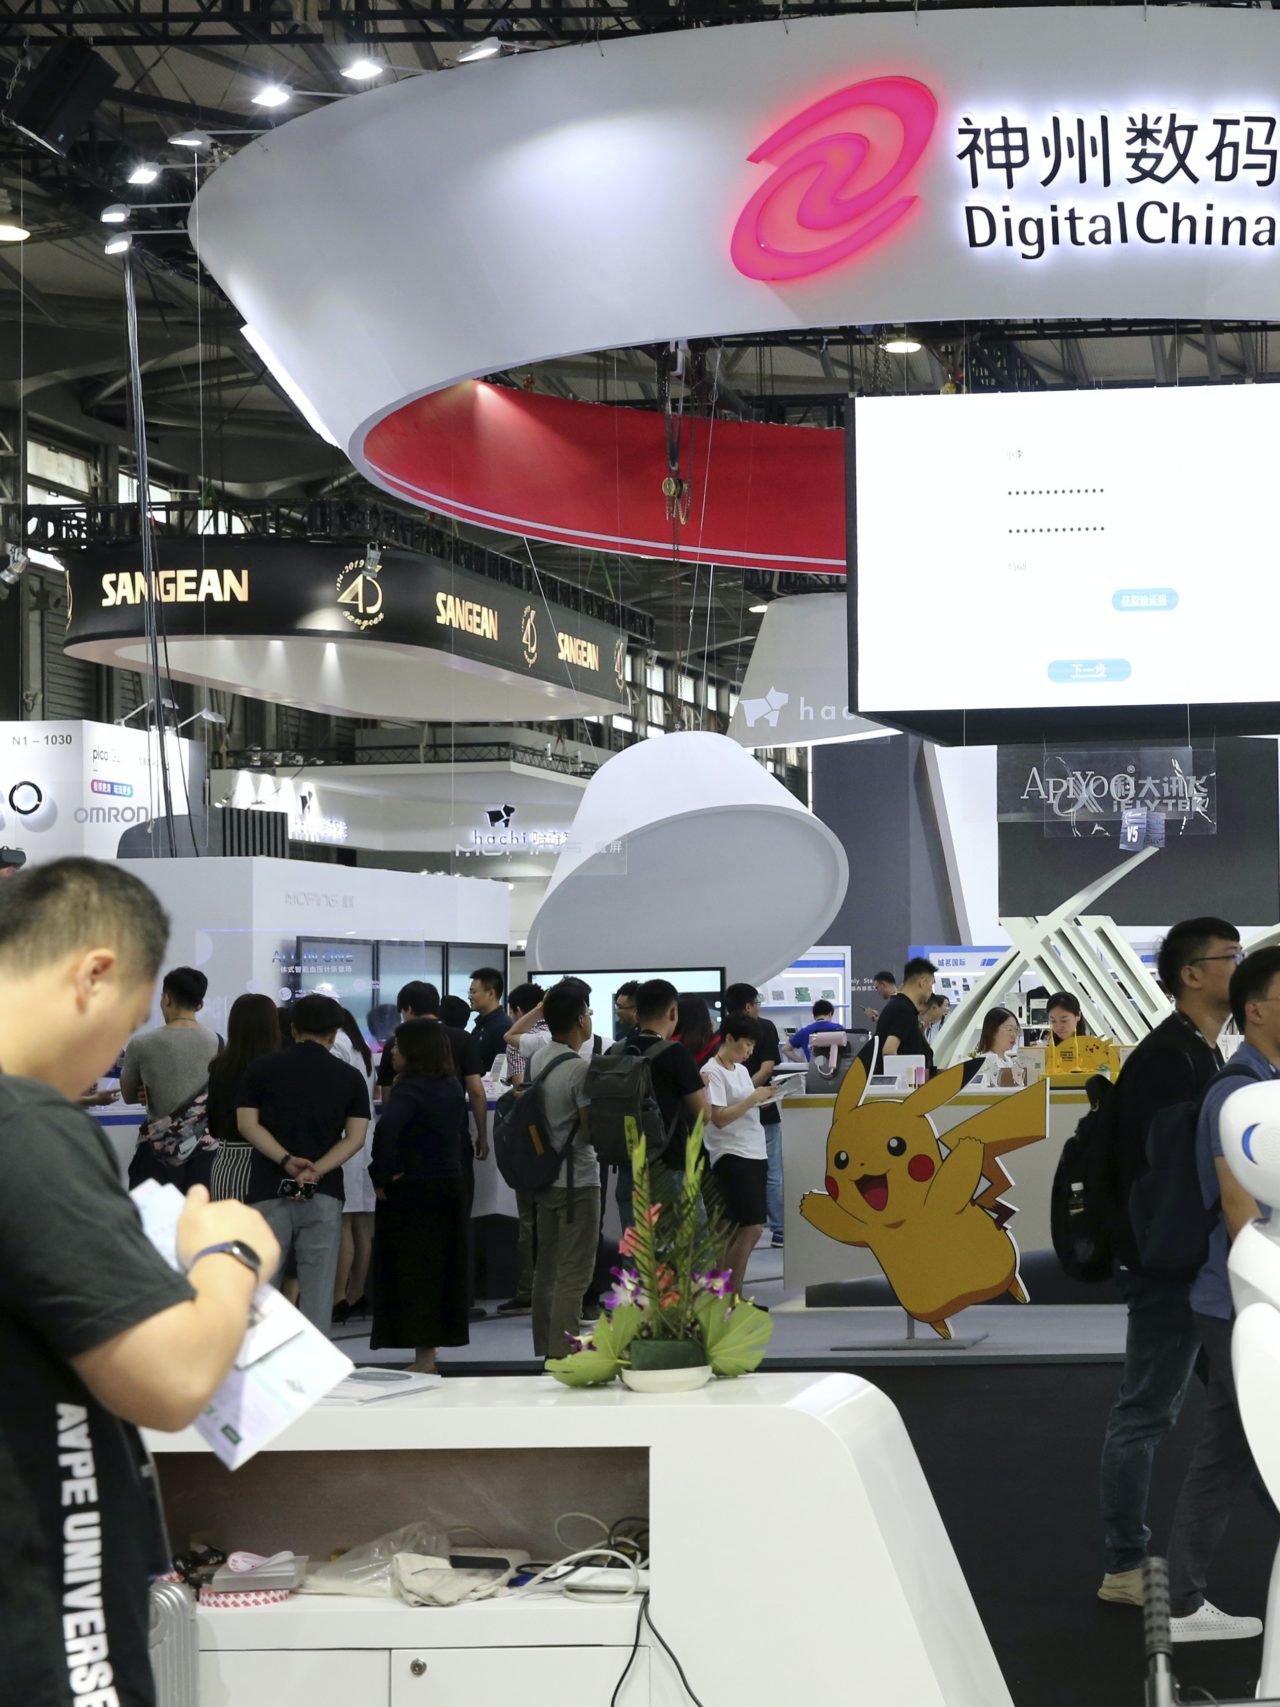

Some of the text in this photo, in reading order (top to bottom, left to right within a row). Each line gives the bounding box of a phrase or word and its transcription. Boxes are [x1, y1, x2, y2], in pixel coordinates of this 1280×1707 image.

[955, 112, 1279, 190] 神州数码
[101, 567, 250, 608] SANGEAN
[435, 591, 498, 641] SANGEAN
[557, 632, 600, 672] SANGEAN
[43, 734, 73, 746] 1030
[92, 747, 109, 762] pico
[472, 829, 527, 846] hachi
[62, 1511, 121, 1707] UNIVERSE
